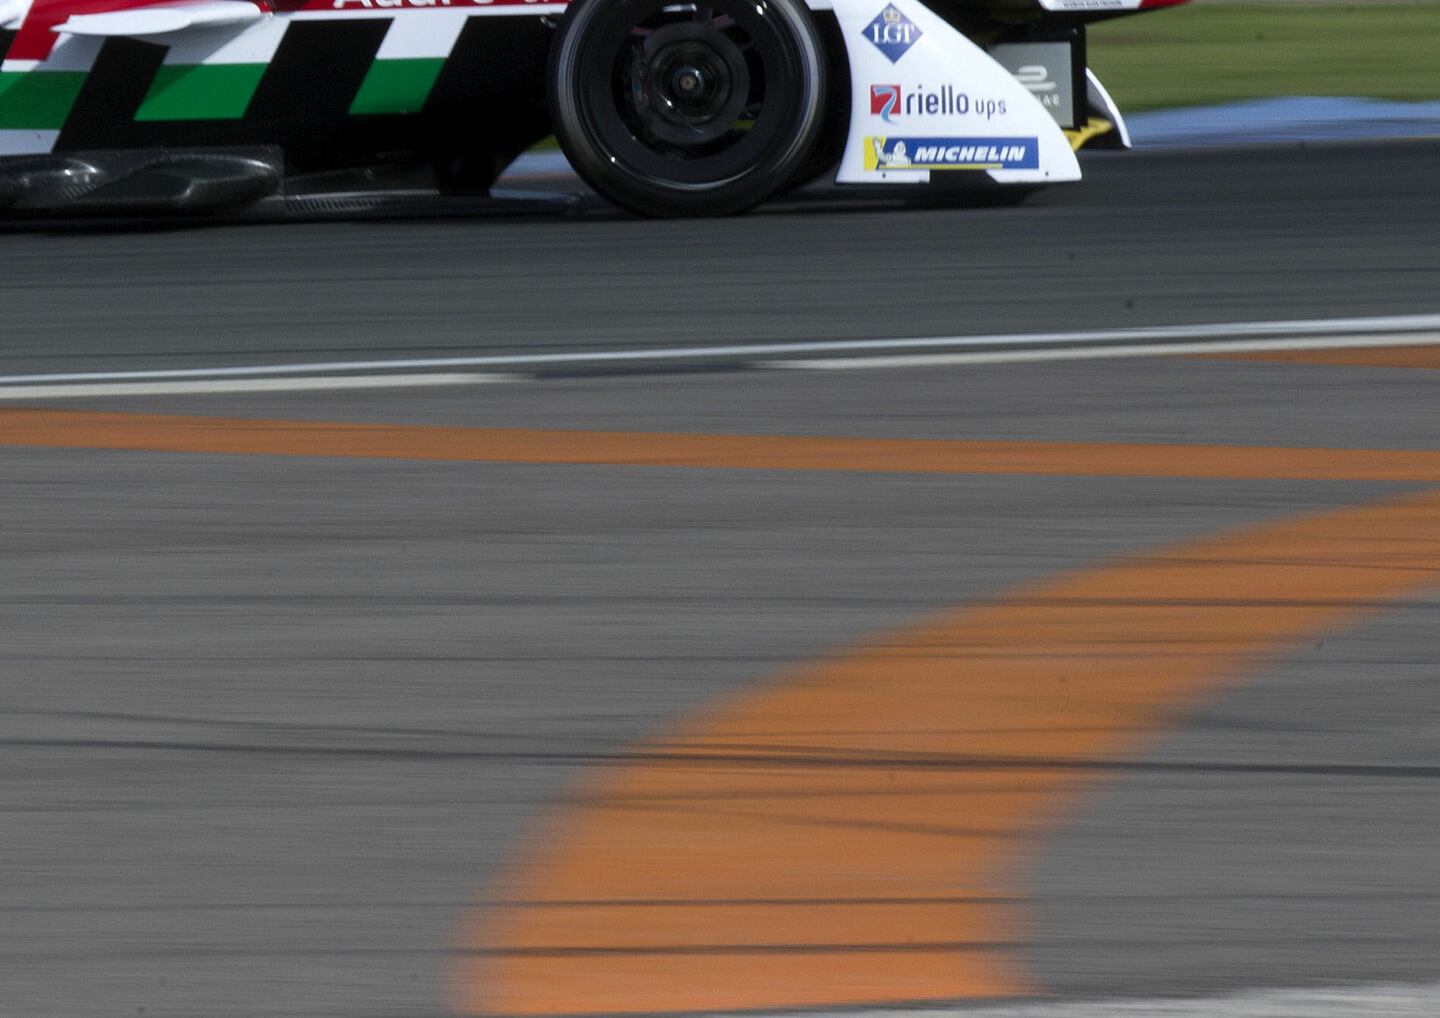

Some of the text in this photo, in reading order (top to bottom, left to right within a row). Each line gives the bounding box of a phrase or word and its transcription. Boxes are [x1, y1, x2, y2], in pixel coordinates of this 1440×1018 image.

[873, 24, 915, 44] LGT
[906, 84, 969, 115] riello
[976, 99, 1007, 120] ups
[914, 146, 1027, 162] MICHELIN
